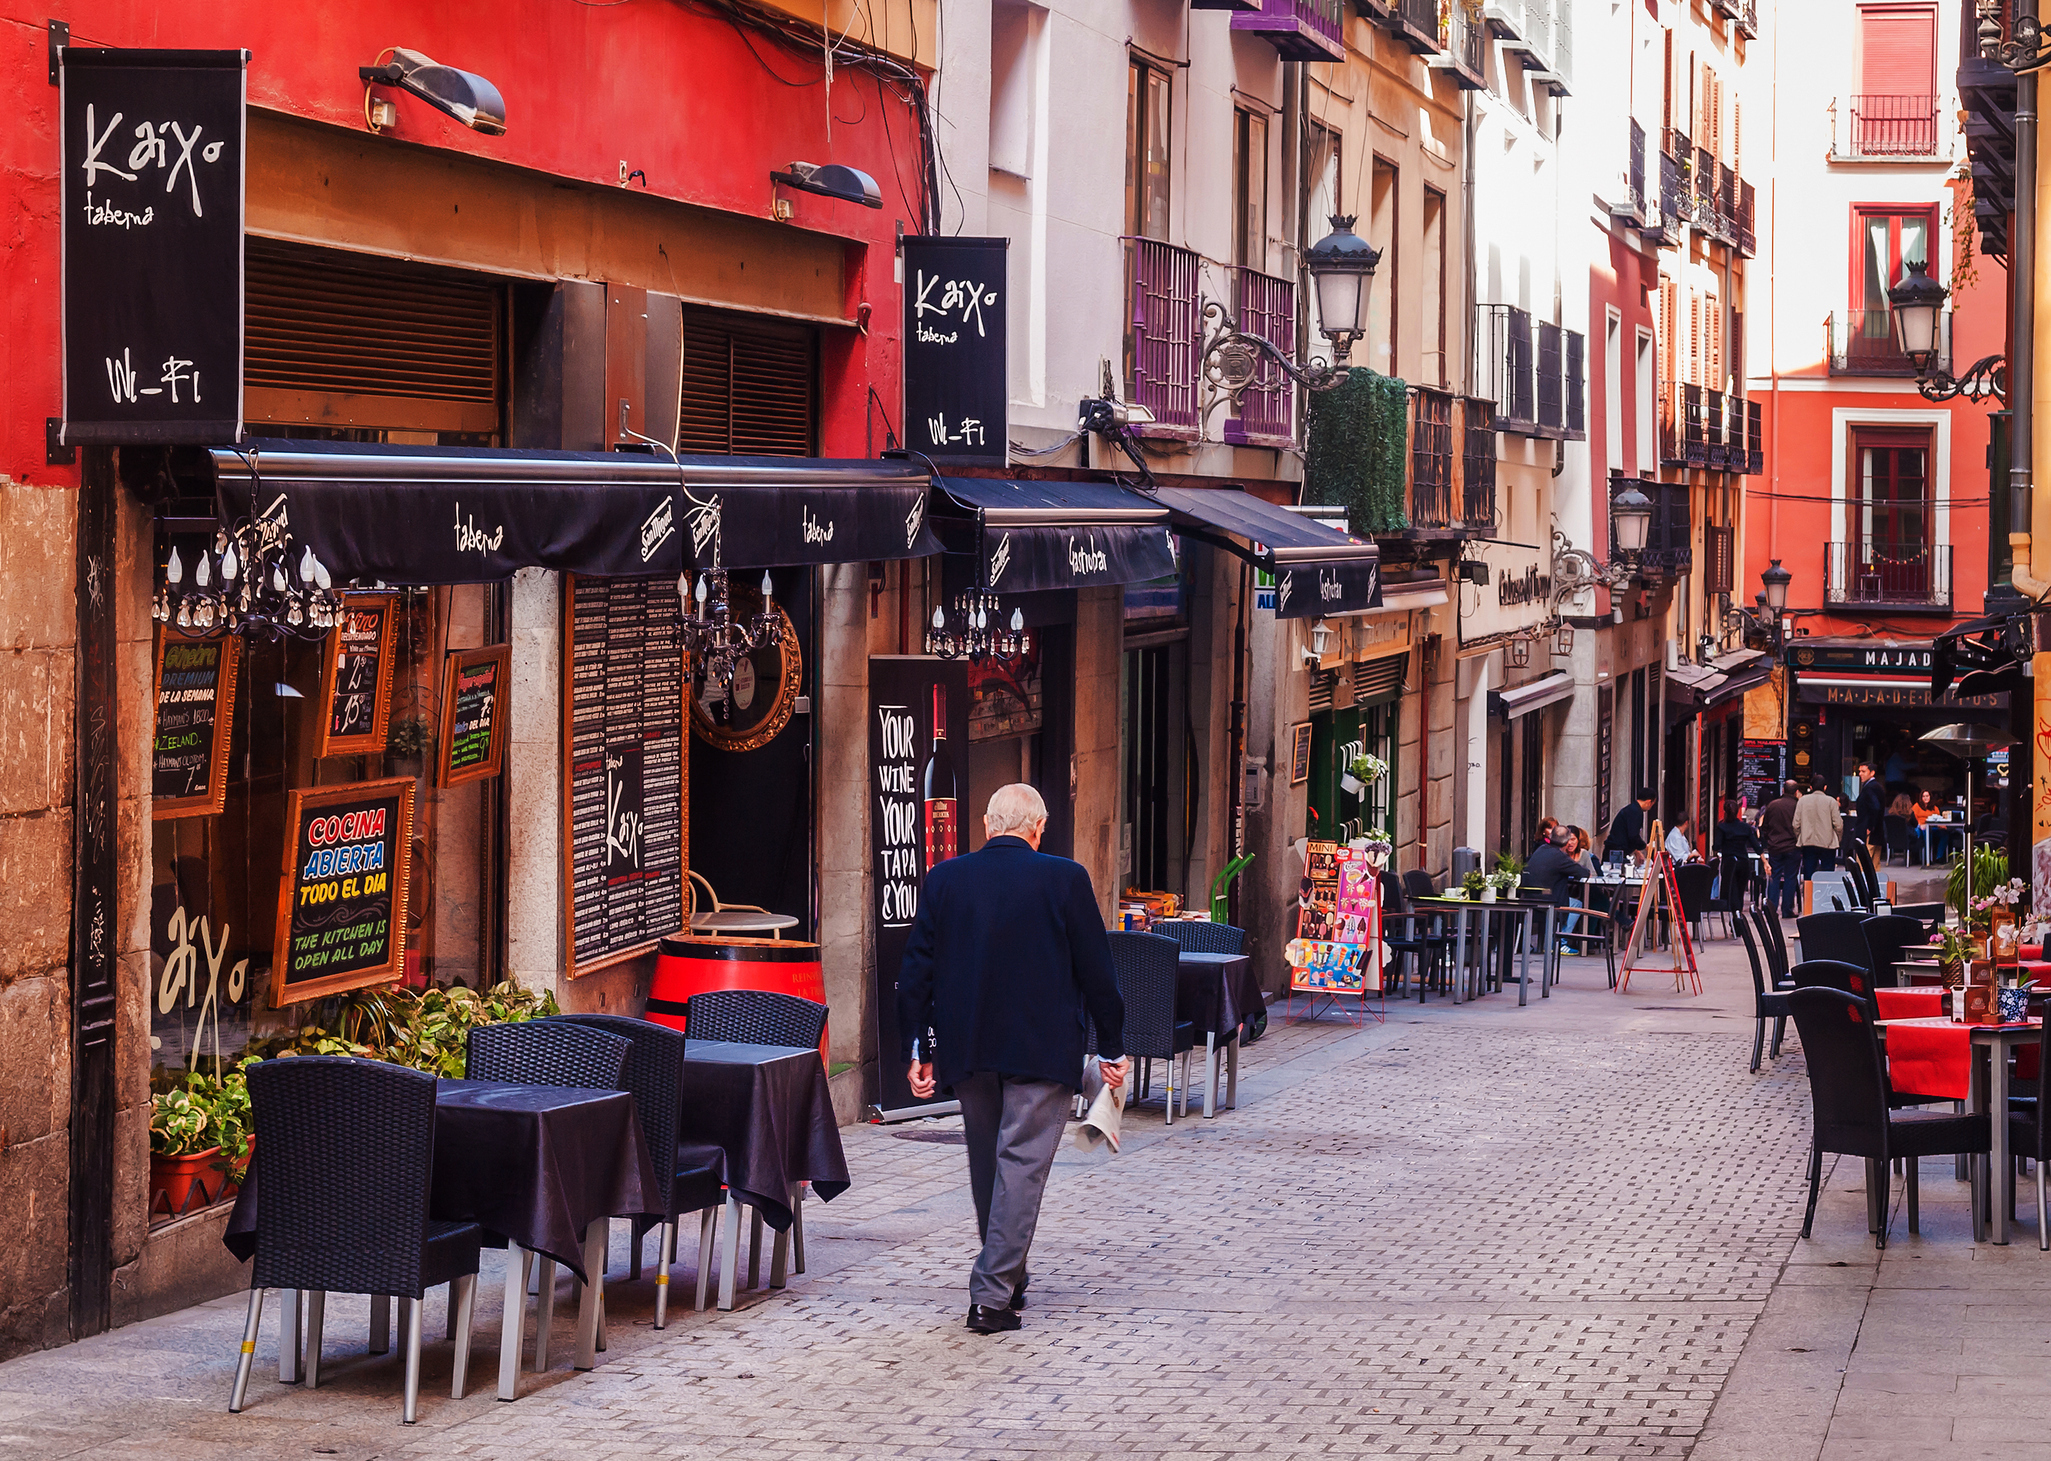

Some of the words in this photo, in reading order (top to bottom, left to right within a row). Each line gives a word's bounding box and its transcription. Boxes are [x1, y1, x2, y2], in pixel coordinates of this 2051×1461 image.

[81, 102, 225, 218] Kaixo
[83, 190, 155, 230] taberna
[914, 269, 997, 338] Kaixo
[916, 321, 958, 345] taberna
[455, 501, 504, 558] taberna
[802, 504, 834, 547] taberna
[1068, 534, 1108, 576] Gastrobar
[161, 671, 216, 687] PREMIUM
[170, 690, 182, 703] LA
[181, 688, 215, 702] SEMANA
[878, 708, 915, 760] YOUR
[878, 761, 915, 794] WINE
[308, 808, 387, 847] COCINA
[879, 795, 917, 847] YOUR
[303, 841, 385, 880] ABIERTA
[880, 848, 917, 880] TAPA
[1308, 843, 1334, 853] MINI
[300, 880, 339, 906] TODO
[341, 878, 361, 898] EL
[364, 872, 387, 896] DIA
[294, 950, 330, 971] OPEN
[331, 945, 355, 963] ALL
[359, 938, 385, 958] DAY
[295, 933, 319, 951] THE
[321, 924, 373, 946] KITCHEN
[376, 919, 387, 935] IS
[151, 906, 250, 1089] aixo
